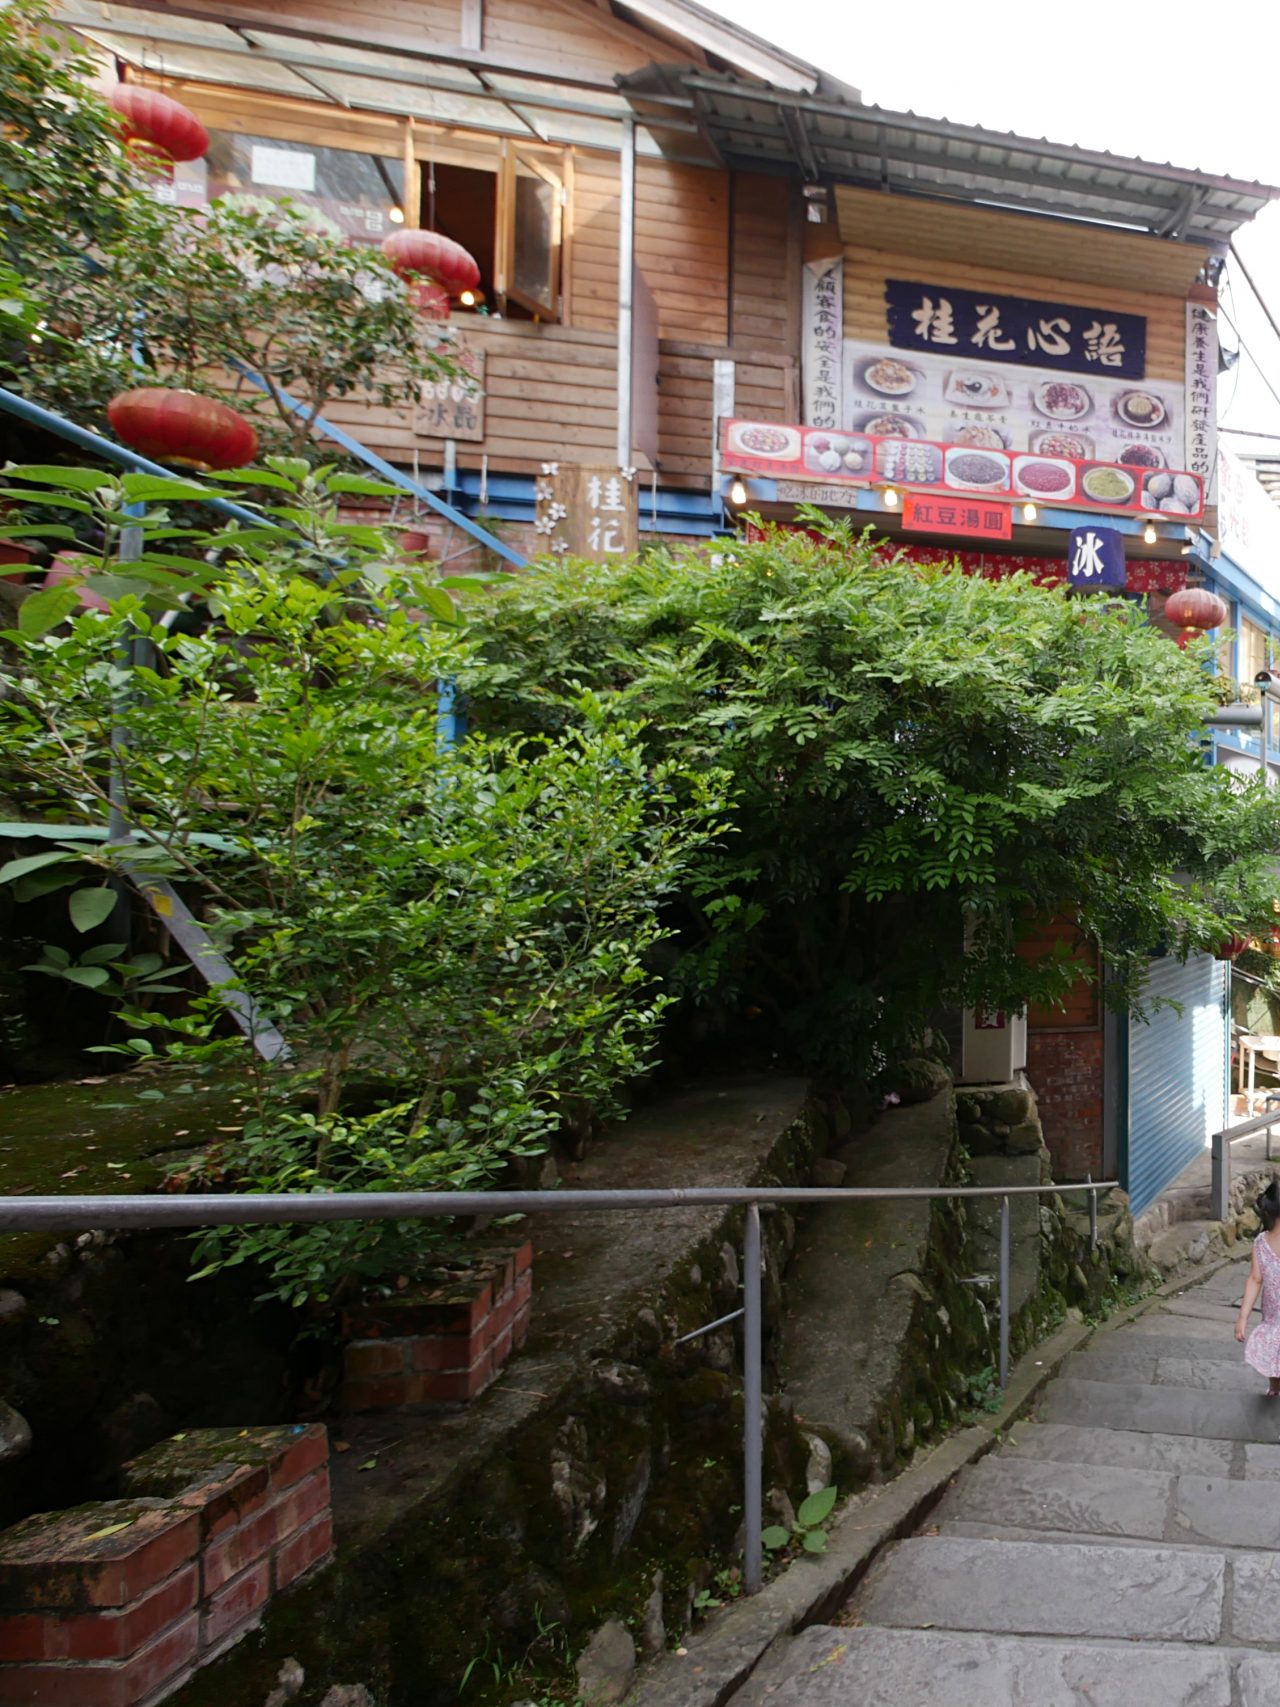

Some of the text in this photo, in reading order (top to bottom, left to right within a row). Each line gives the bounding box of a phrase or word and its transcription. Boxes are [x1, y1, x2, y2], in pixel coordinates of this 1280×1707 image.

[912, 296, 1125, 367] 桂花心語
[587, 475, 626, 553] 桂花
[913, 503, 1003, 531] 紅豆湯圓
[1072, 532, 1105, 577] 冰
